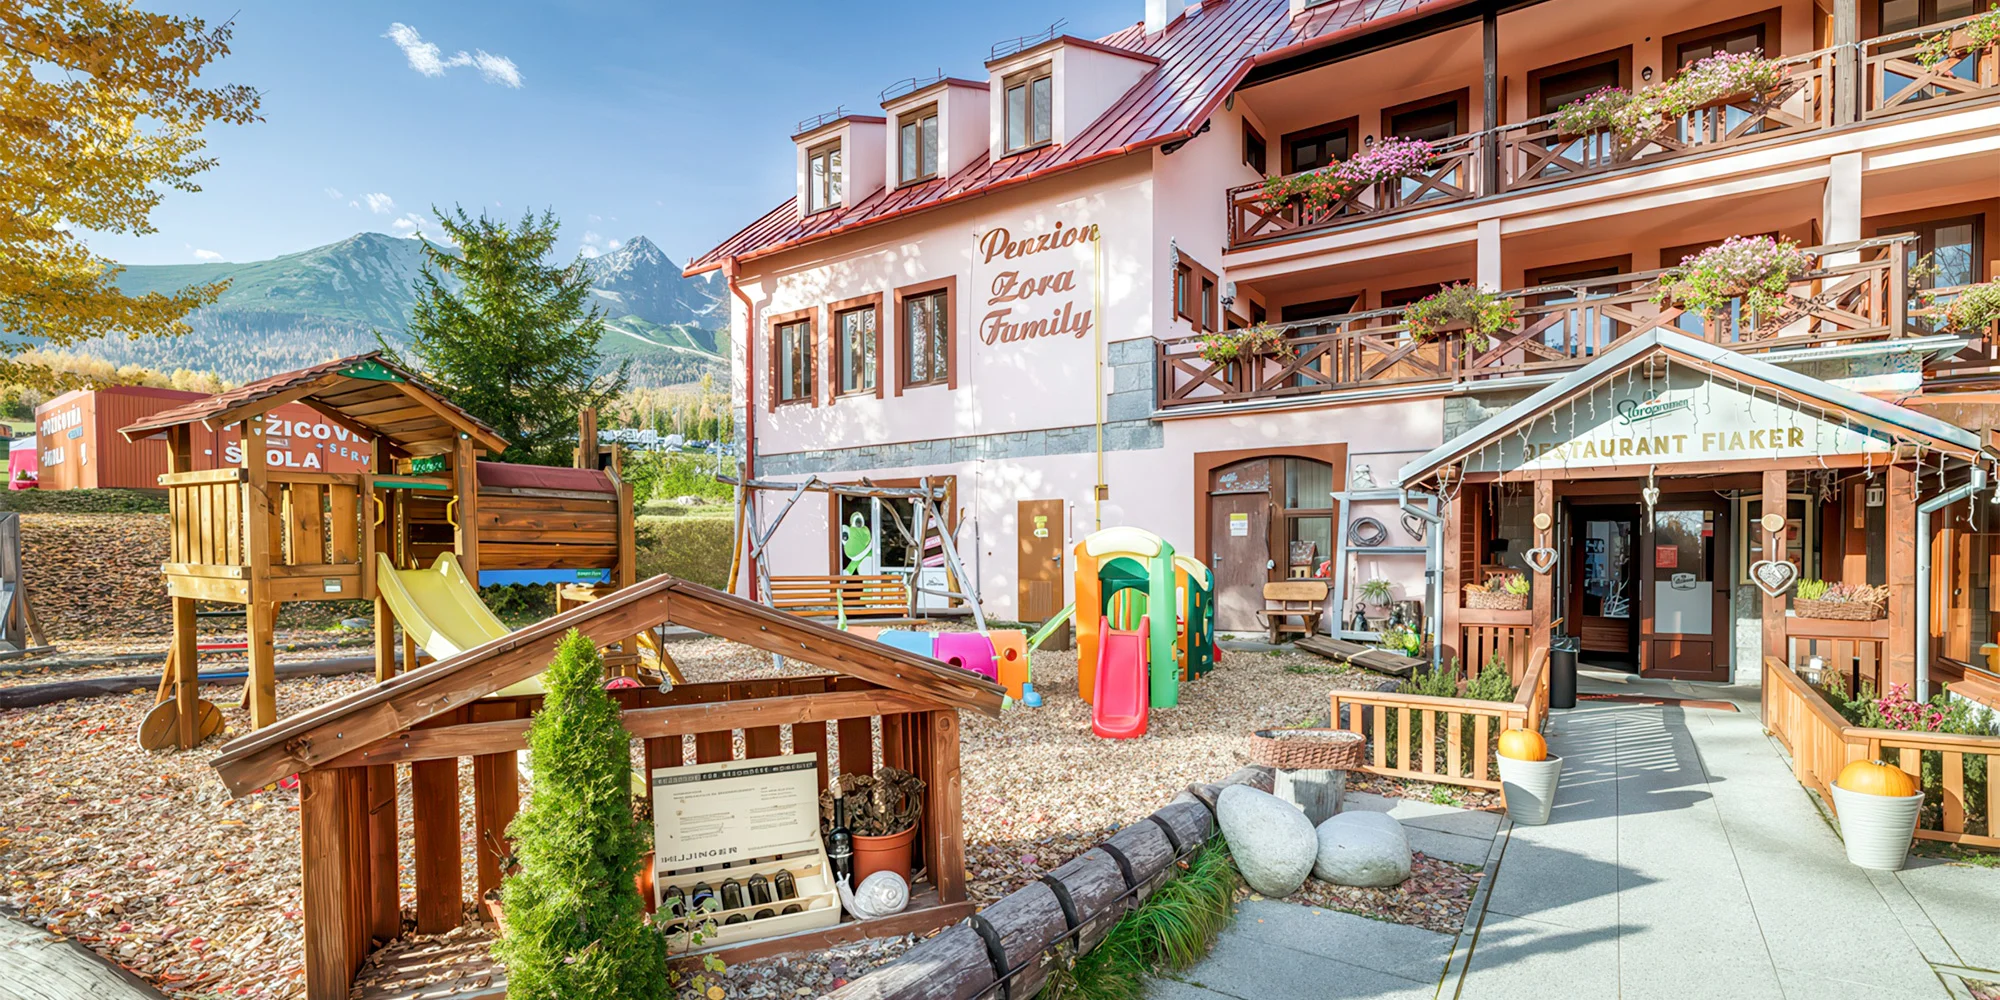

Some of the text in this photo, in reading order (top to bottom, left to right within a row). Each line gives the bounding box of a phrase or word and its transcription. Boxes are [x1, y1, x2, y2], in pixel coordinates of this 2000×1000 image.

[979, 221, 1098, 264] Penzion
[987, 269, 1076, 306] Zora
[979, 301, 1093, 346] Family
[225, 441, 321, 469] ŠOLA
[1524, 427, 1804, 462] RESTAURANT FIAKER
